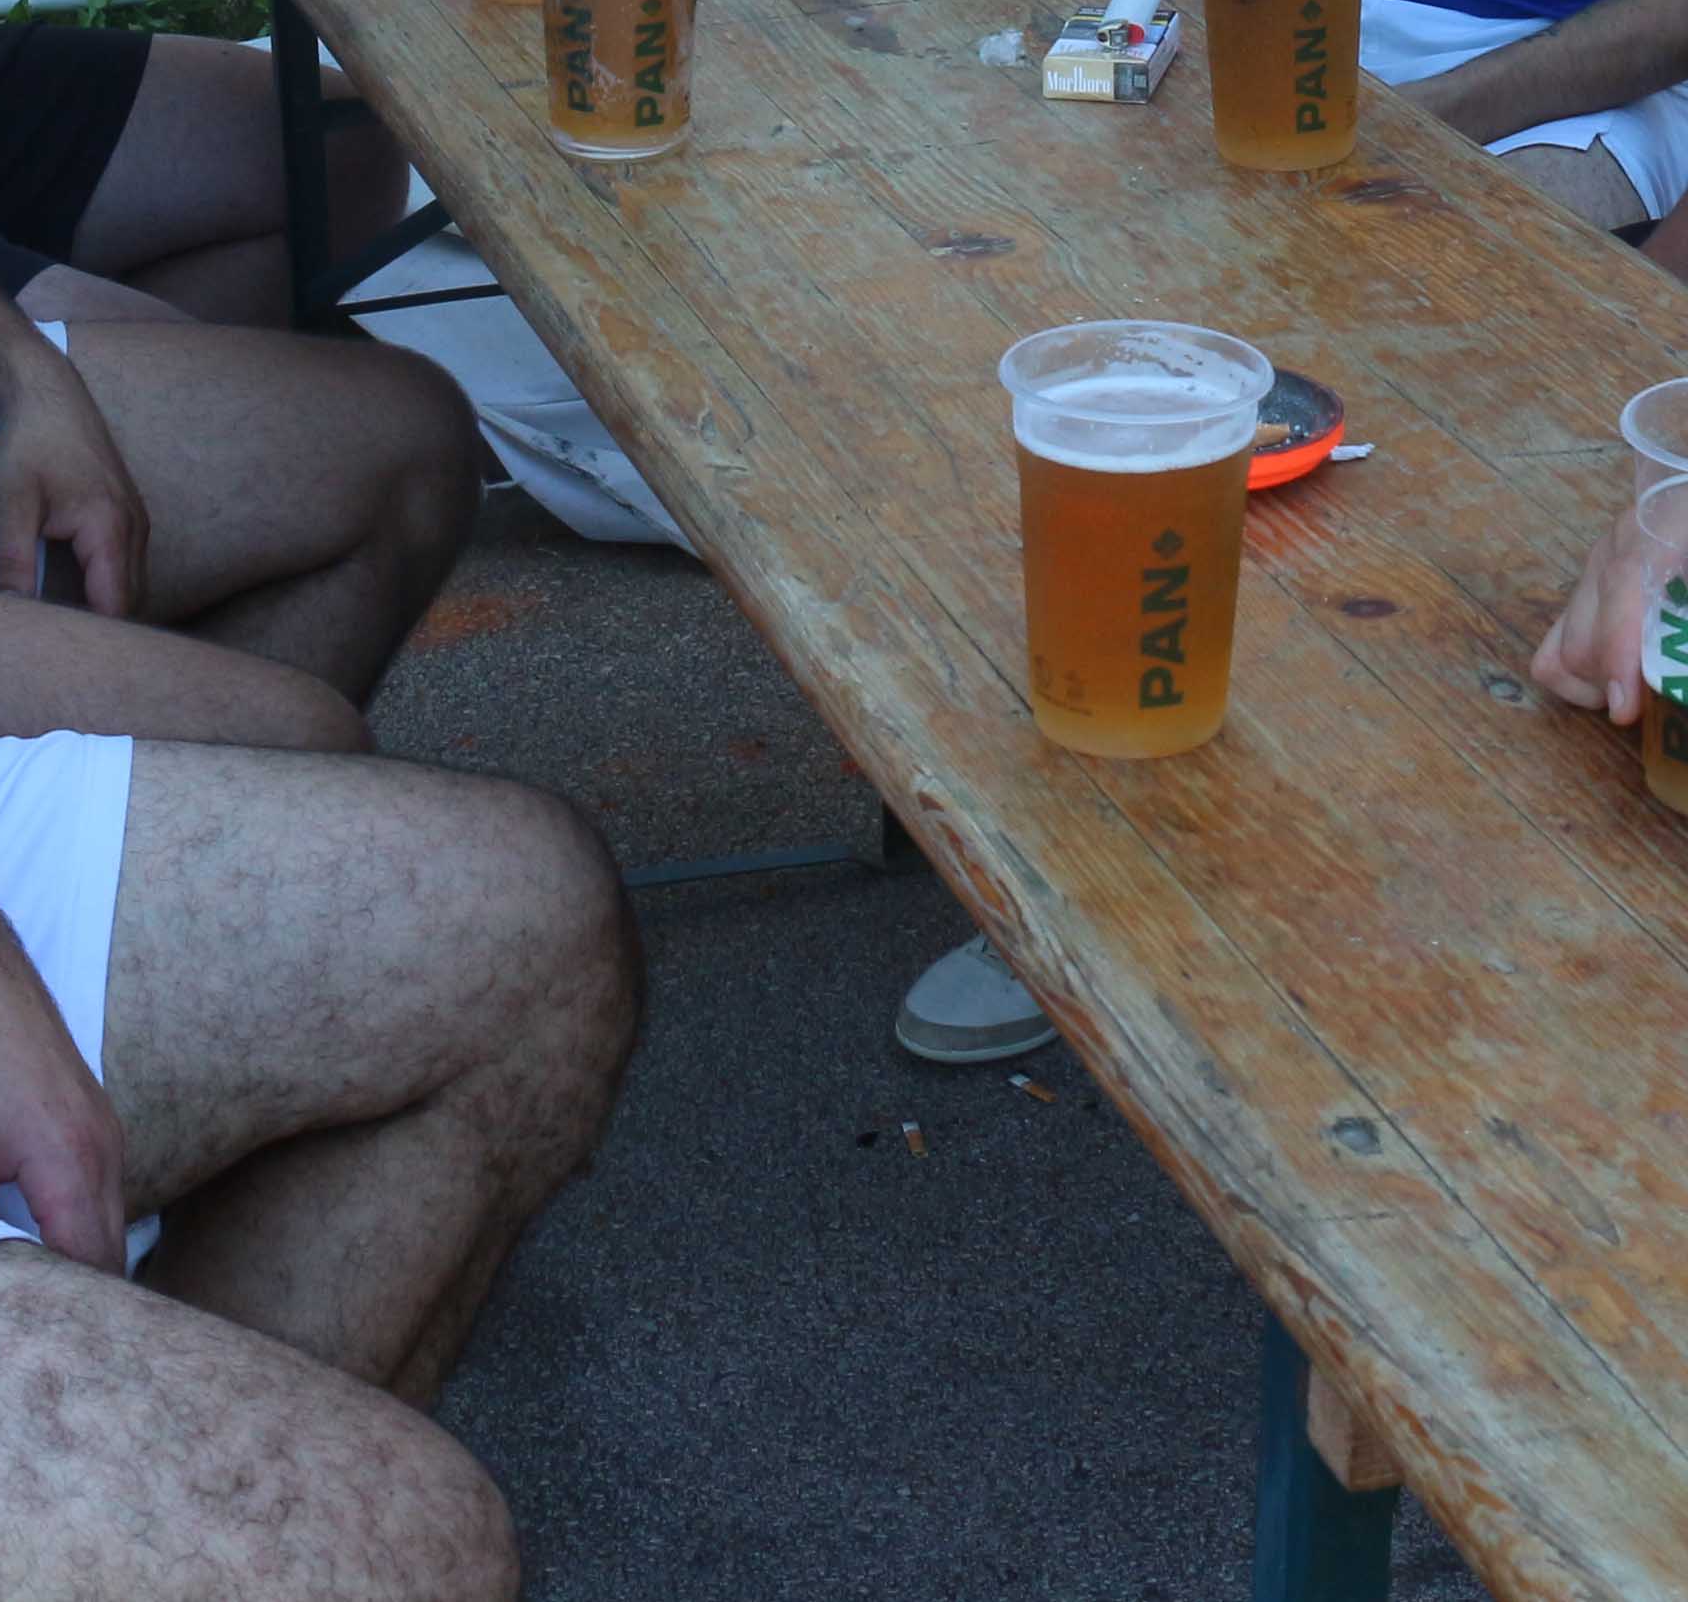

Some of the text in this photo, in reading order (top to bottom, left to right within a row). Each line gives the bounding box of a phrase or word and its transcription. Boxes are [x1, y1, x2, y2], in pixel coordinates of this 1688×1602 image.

[567, 3, 593, 113] PAN
[635, 19, 666, 127] PAN
[1047, 65, 1112, 94] Marlboro
[1293, 28, 1327, 135] PAN
[1139, 565, 1189, 710] PAN
